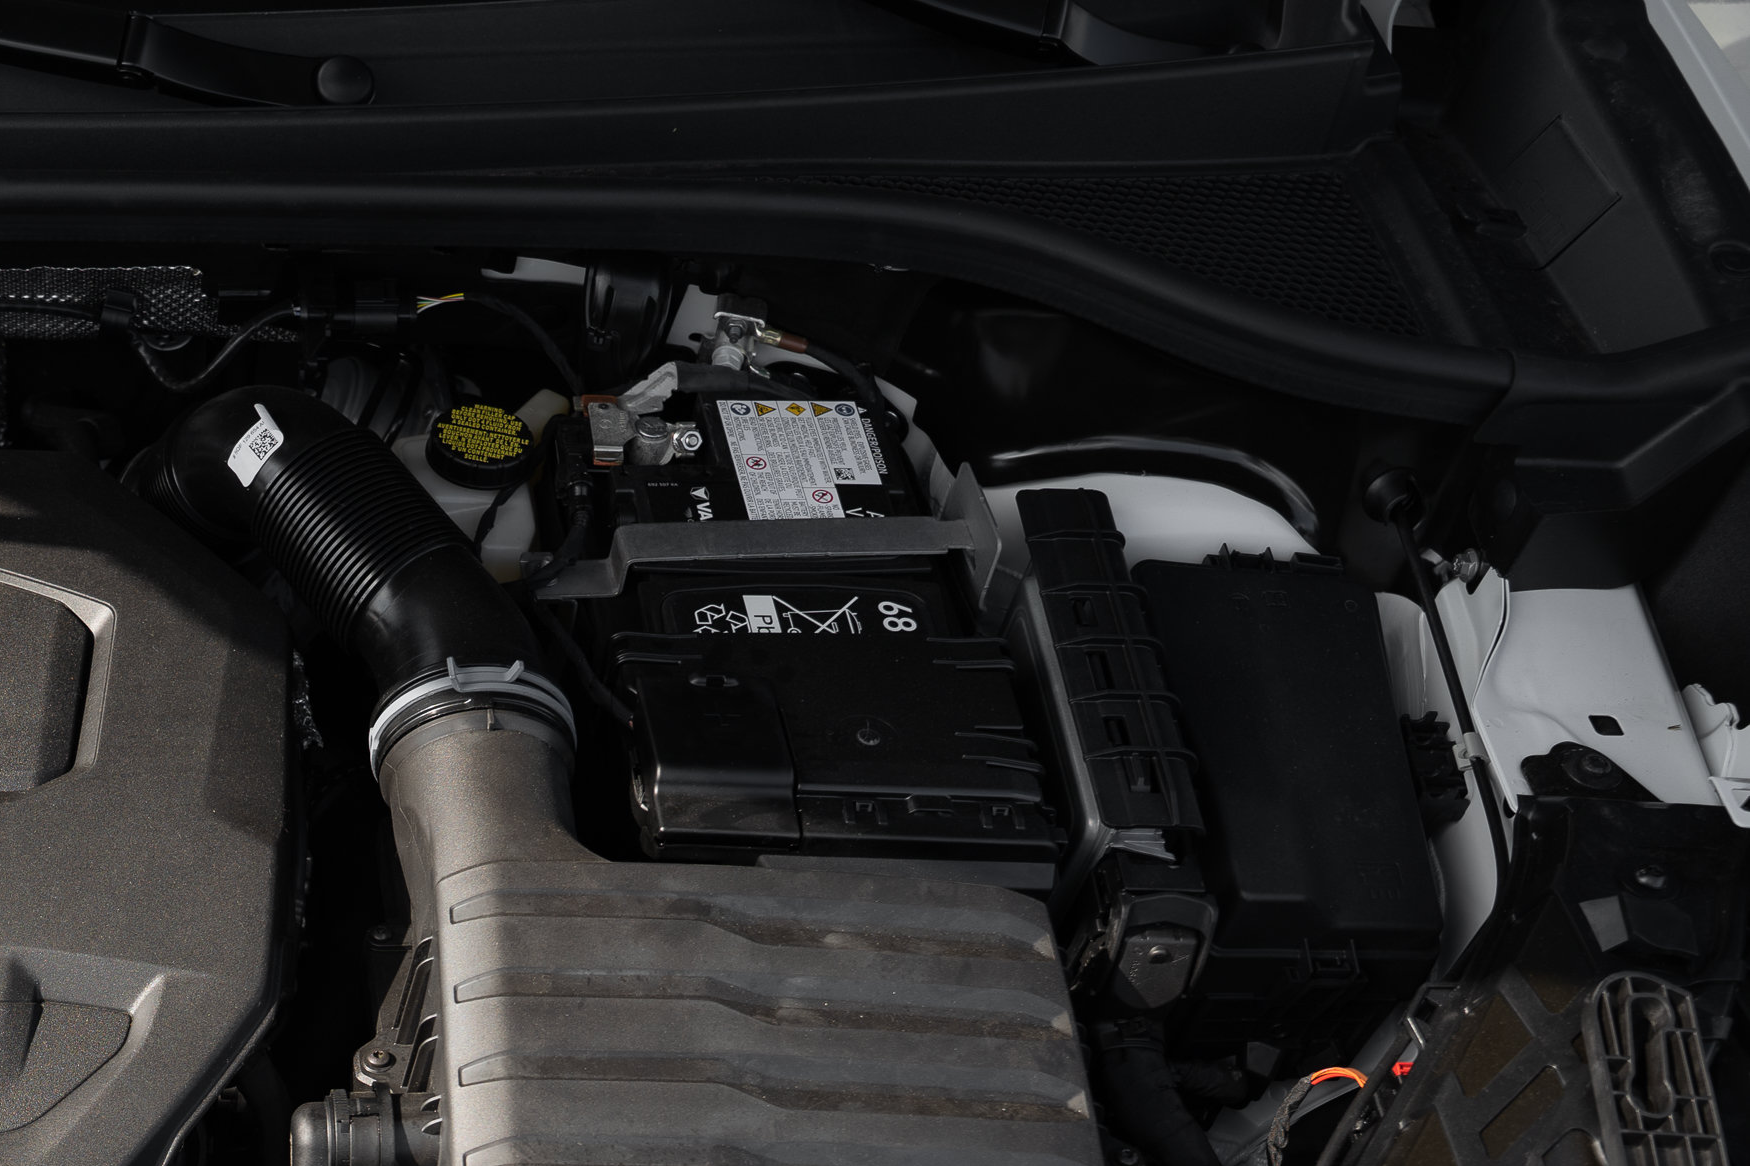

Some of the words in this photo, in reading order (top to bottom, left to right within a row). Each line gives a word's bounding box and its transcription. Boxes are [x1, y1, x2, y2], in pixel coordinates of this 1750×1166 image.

[452, 413, 467, 422] ONLY
[486, 421, 503, 429] FLUID
[461, 405, 480, 415] CLEAN
[482, 410, 502, 419] FILLER
[503, 414, 515, 422] CAP
[458, 420, 480, 429] SEALED
[696, 502, 713, 520] VA
[877, 601, 917, 632] 68
